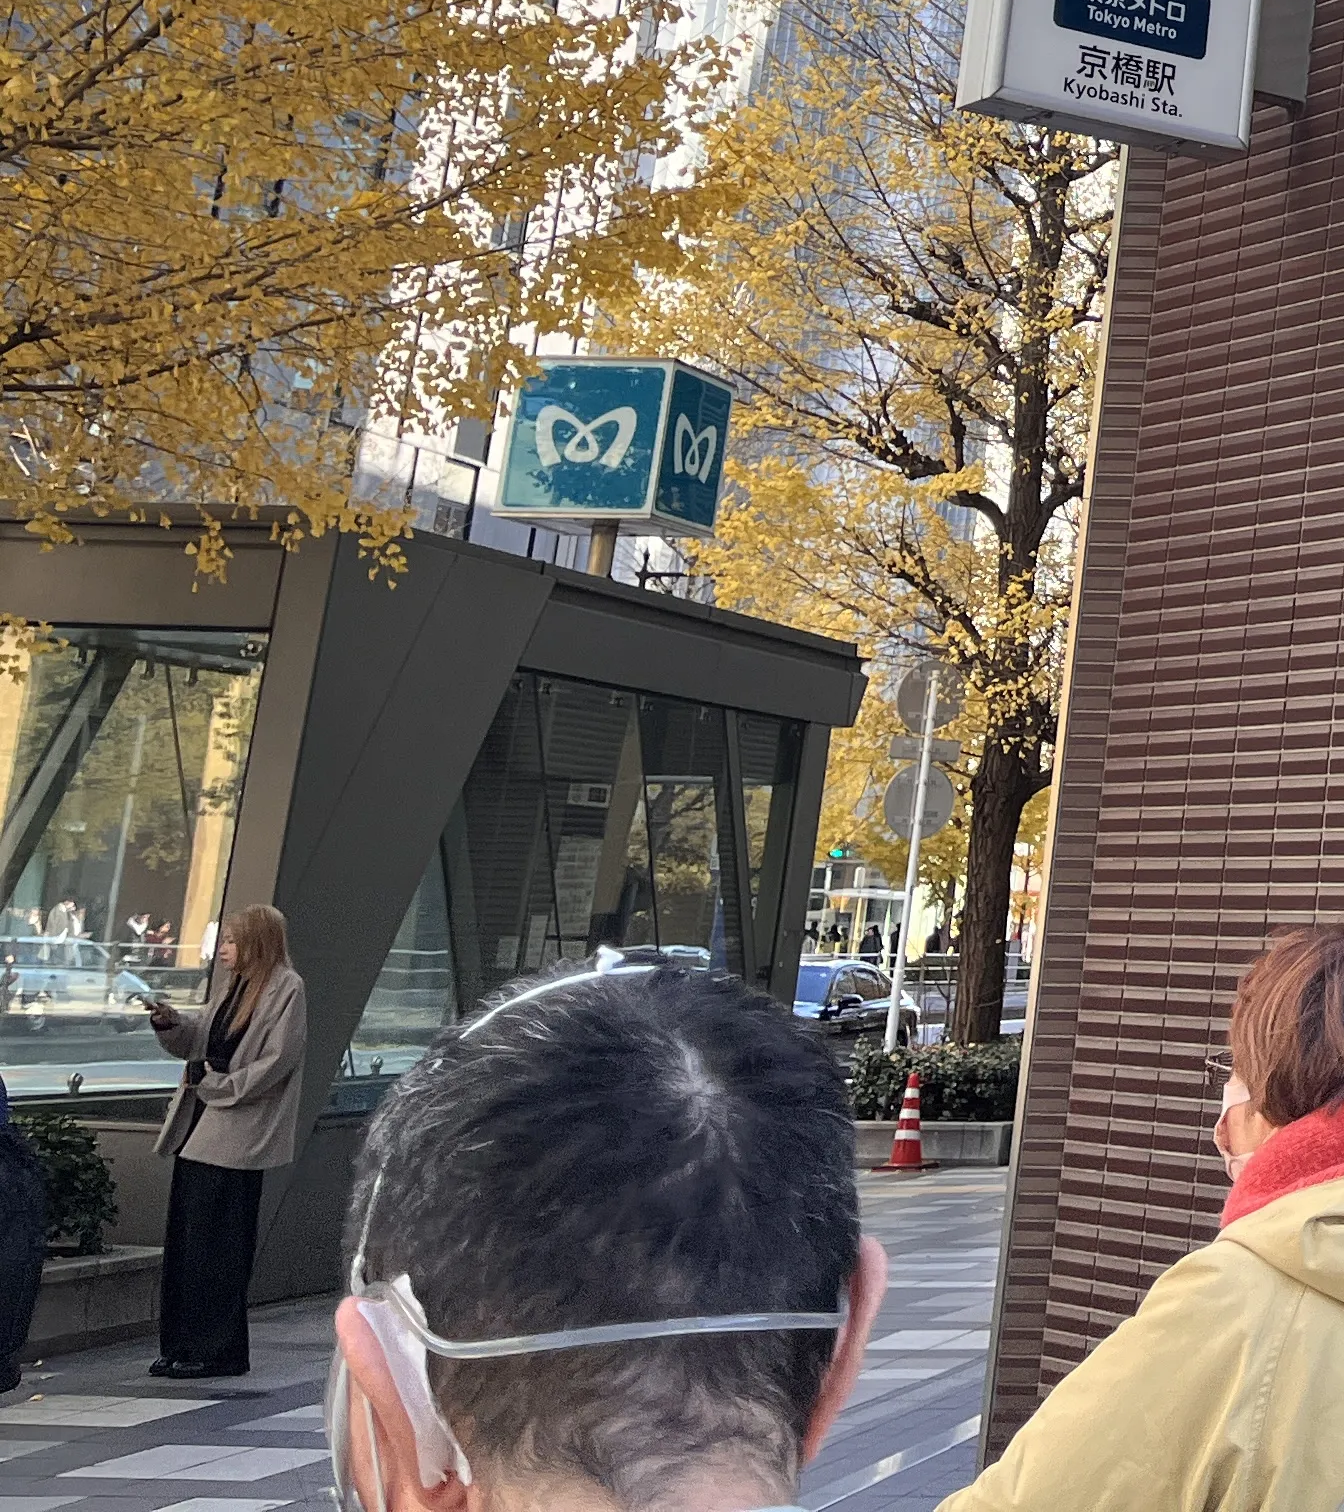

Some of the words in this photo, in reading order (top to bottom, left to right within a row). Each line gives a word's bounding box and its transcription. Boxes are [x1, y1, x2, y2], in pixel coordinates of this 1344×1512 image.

[1087, 4, 1130, 29] Tokyo
[1134, 16, 1177, 40] Metro
[1076, 44, 1177, 96] 京橋駅
[1063, 76, 1146, 110] Kyobashi
[1151, 95, 1183, 118] Sta.
